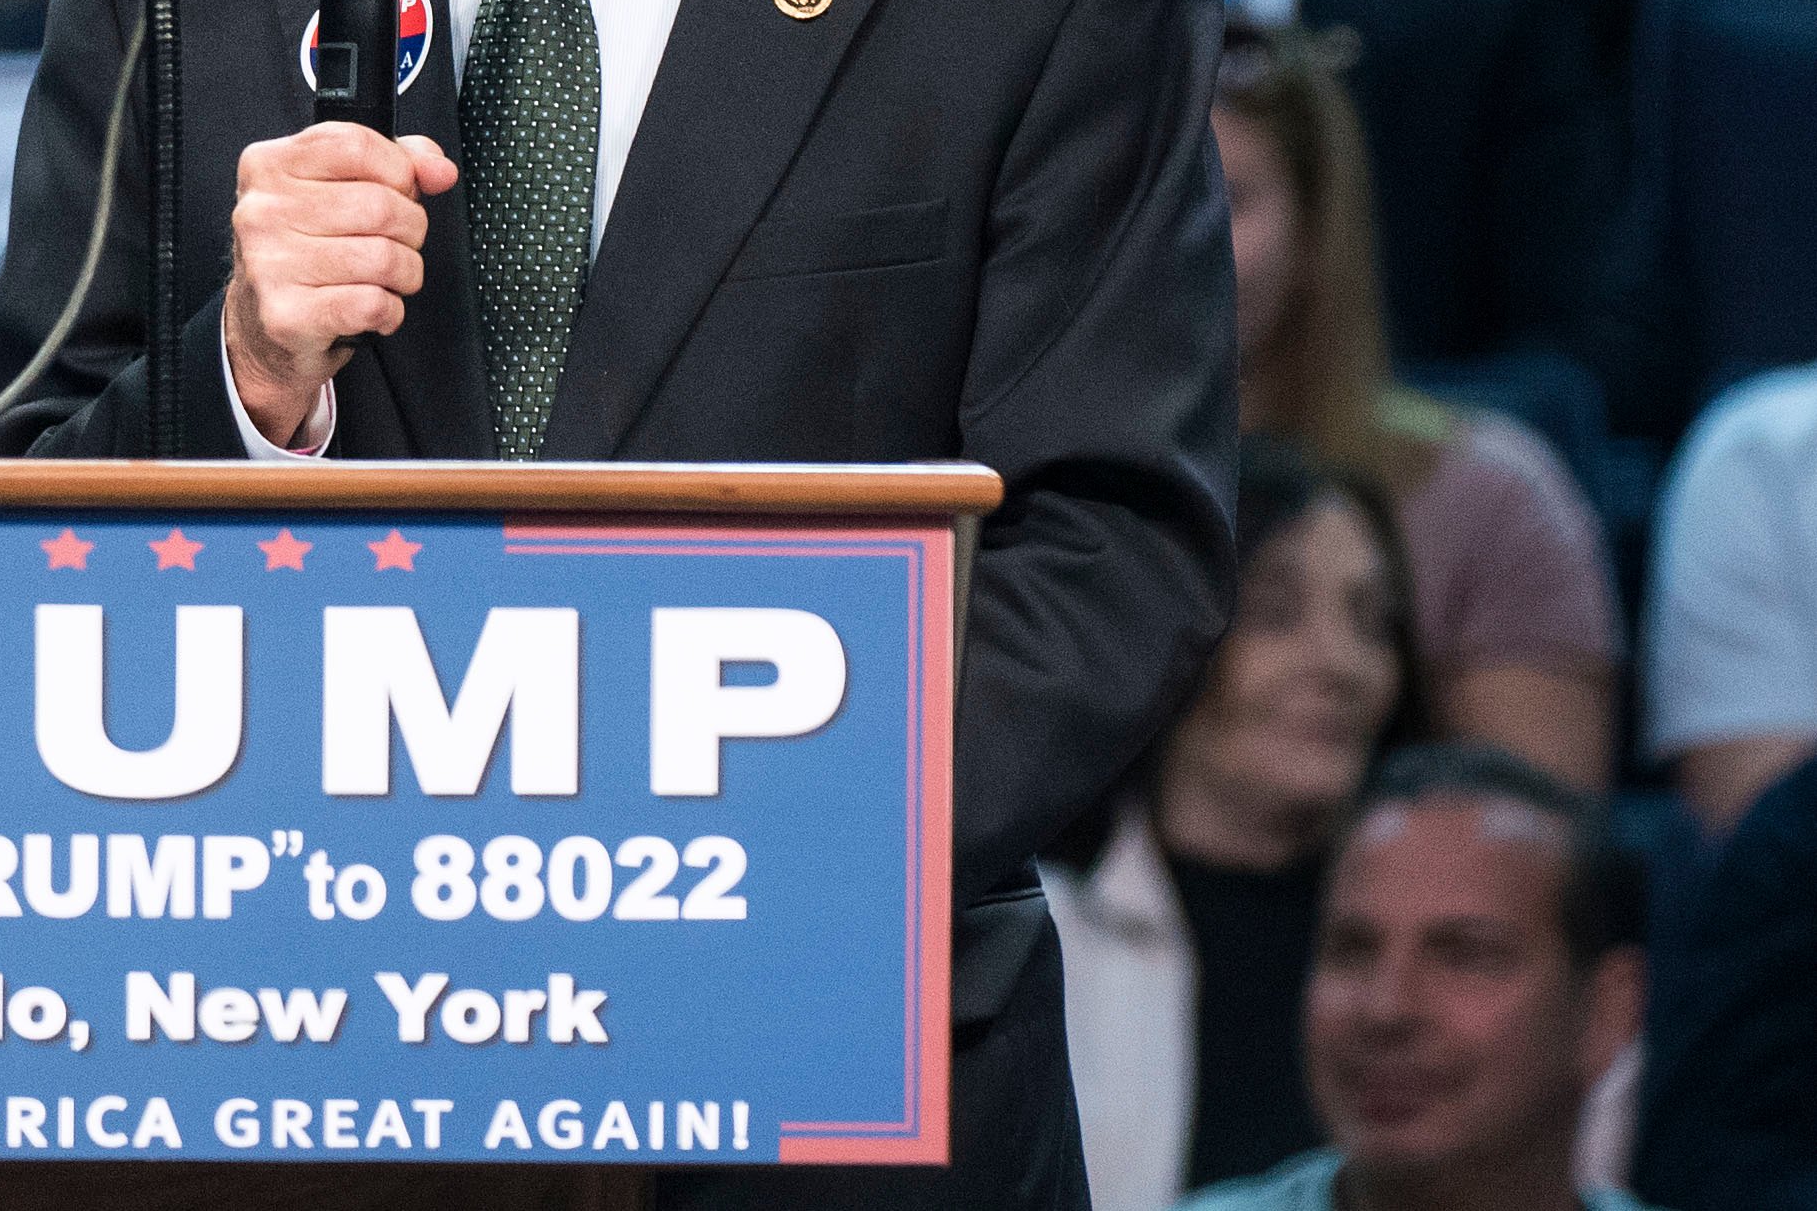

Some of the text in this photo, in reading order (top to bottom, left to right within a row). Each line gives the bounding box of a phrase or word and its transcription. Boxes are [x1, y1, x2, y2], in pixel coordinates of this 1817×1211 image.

[302, 850, 387, 920] to
[411, 834, 748, 921] 88022
[126, 971, 348, 1042] New
[375, 972, 609, 1044] York
[213, 1098, 453, 1149] GREAT
[485, 1099, 750, 1151] AGAIN!
